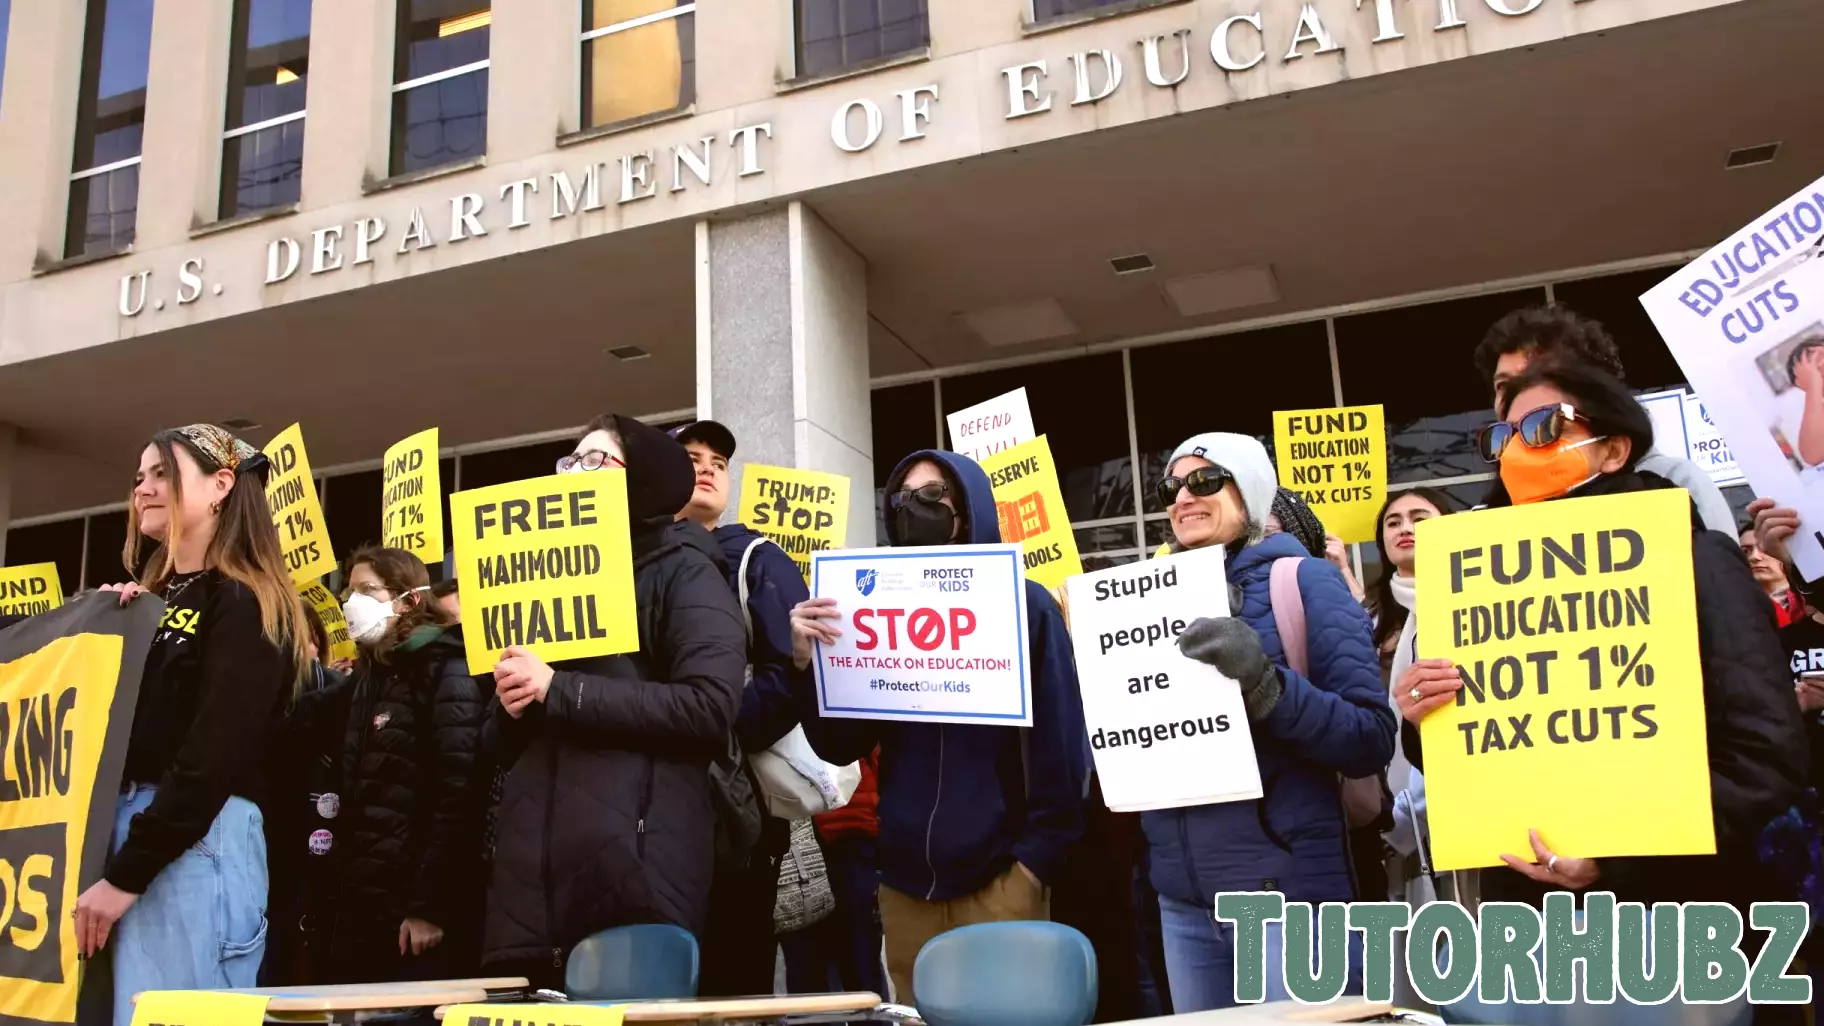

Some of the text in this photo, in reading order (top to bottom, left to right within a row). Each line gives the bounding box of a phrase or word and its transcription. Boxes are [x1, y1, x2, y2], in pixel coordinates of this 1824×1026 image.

[118, 256, 224, 318] U.S.
[263, 121, 773, 287] DEPARTMENT
[829, 83, 940, 154] OF
[1721, 279, 1800, 344] CUTS
[960, 412, 1012, 437] DEFEND
[1288, 411, 1368, 436] FUND
[267, 443, 297, 482] ND
[1290, 437, 1370, 460] EDUCATION
[1292, 460, 1371, 485] NOT 1%
[757, 477, 836, 505] TRUMP:
[1331, 486, 1373, 503] CUTS
[285, 508, 314, 541] 1%
[399, 503, 424, 528] 1%
[474, 489, 598, 540] FREE
[752, 497, 834, 531] STOP
[477, 543, 601, 590] MAHMOUD
[923, 568, 973, 579] PROTECT
[1449, 528, 1645, 594] FUND
[938, 580, 970, 592] KIDS
[1094, 565, 1178, 602] Stupid
[481, 594, 607, 650] KHALIL
[852, 607, 977, 652] STOP
[1452, 586, 1650, 648] EDUCATION
[828, 656, 1012, 671] THE ATTACK ON EDUCATION!
[1455, 642, 1655, 707] NOT 1%
[869, 678, 971, 693] #ProtectOurKids
[1127, 671, 1170, 694] are
[1091, 714, 1231, 750] dangerous
[1458, 704, 1659, 756] TAX CUTS
